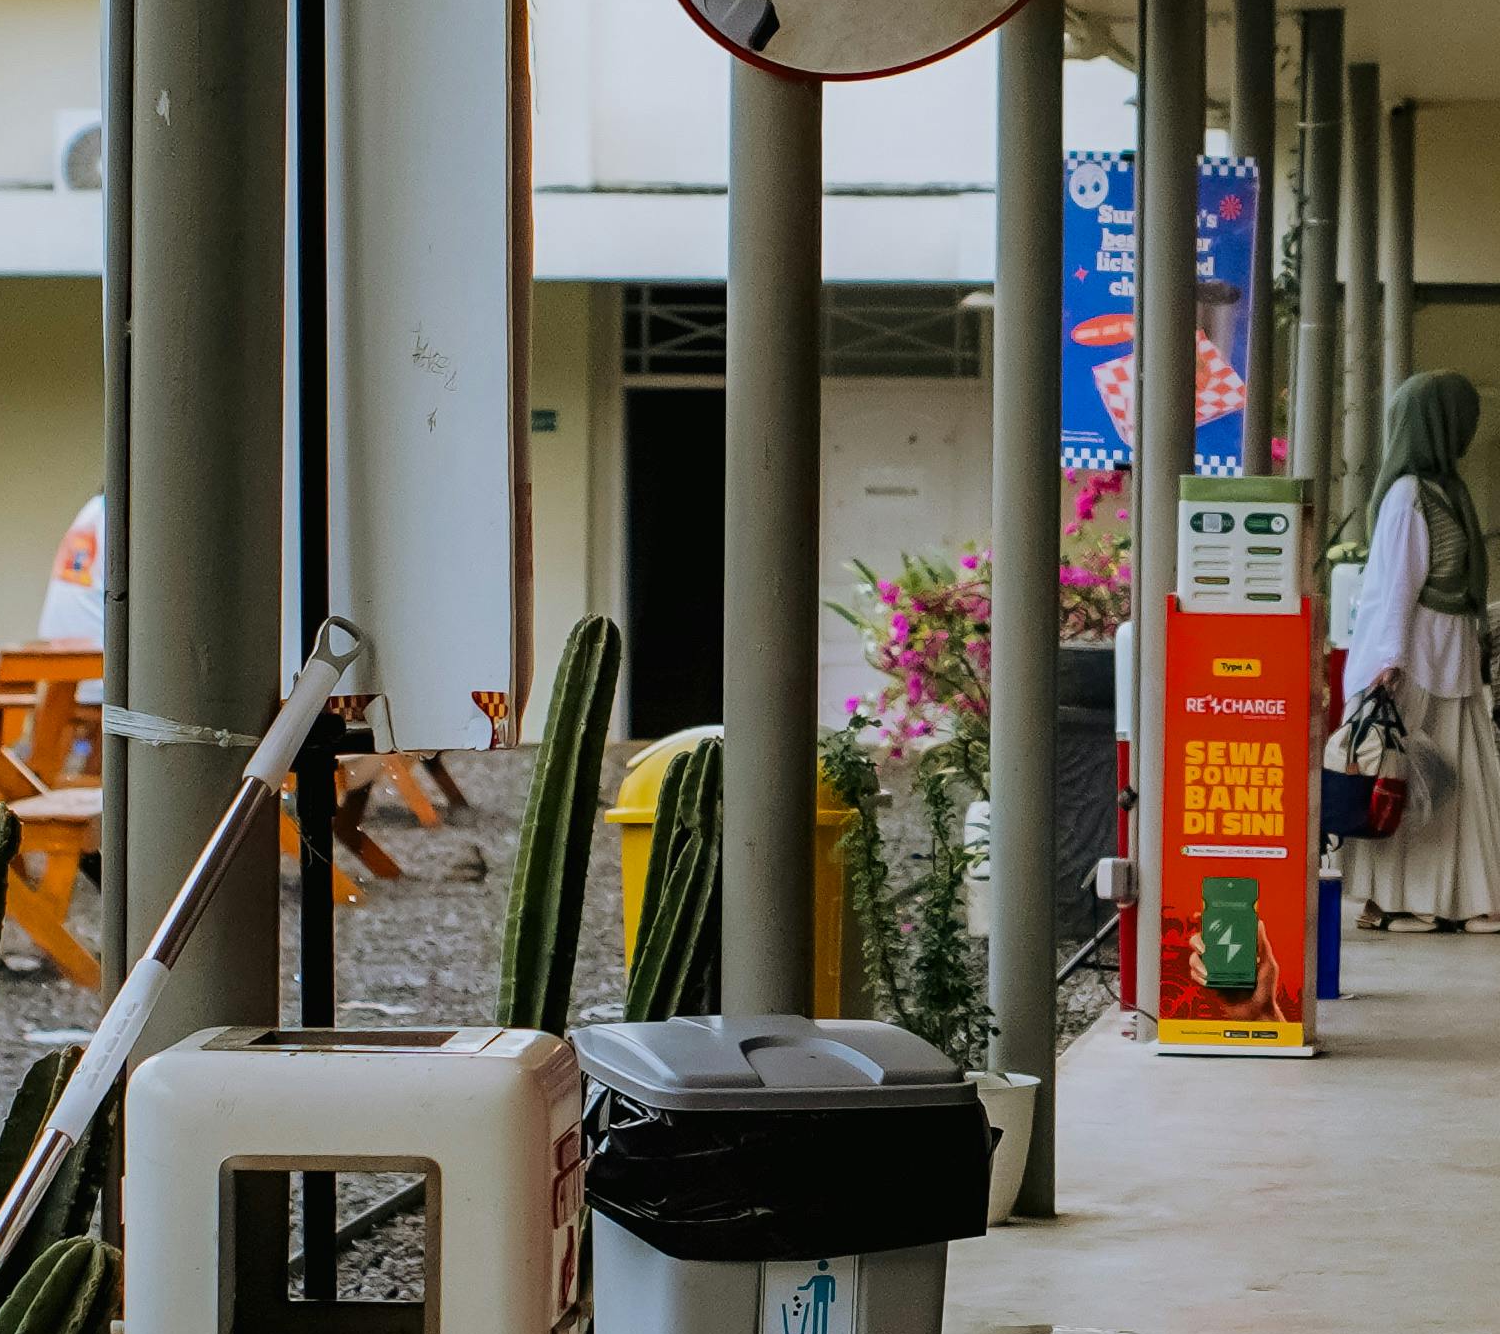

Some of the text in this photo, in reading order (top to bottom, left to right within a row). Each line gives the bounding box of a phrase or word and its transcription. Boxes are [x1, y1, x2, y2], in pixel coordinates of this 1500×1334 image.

[1220, 662, 1253, 672] Type A
[1183, 740, 1285, 767] SEWA
[1184, 766, 1285, 786] POWER
[1184, 785, 1285, 812] BANK
[1183, 812, 1285, 837] DI SINI
